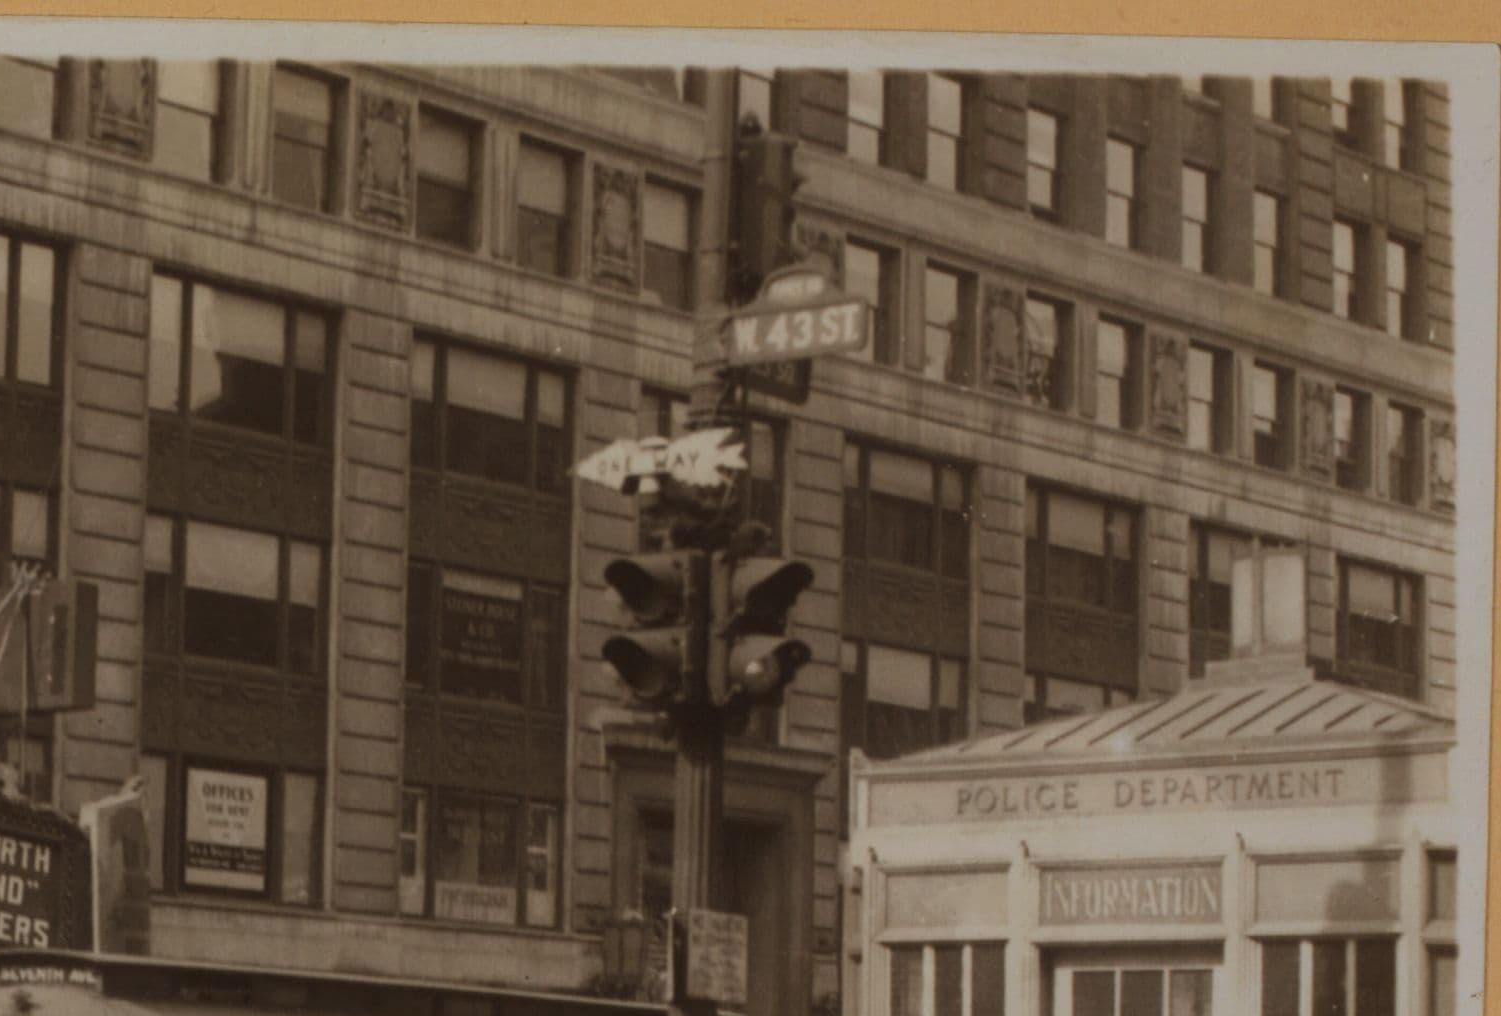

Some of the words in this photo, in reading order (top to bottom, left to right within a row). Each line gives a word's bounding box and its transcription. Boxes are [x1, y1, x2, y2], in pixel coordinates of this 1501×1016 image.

[765, 310, 813, 352] 43
[597, 455, 632, 477] ONE
[654, 450, 700, 470] WAY
[201, 781, 254, 802] OFFICES
[955, 779, 1081, 816] POLICE
[1113, 768, 1346, 809] DEPARTMENT
[1045, 872, 1221, 919] INFORMATION
